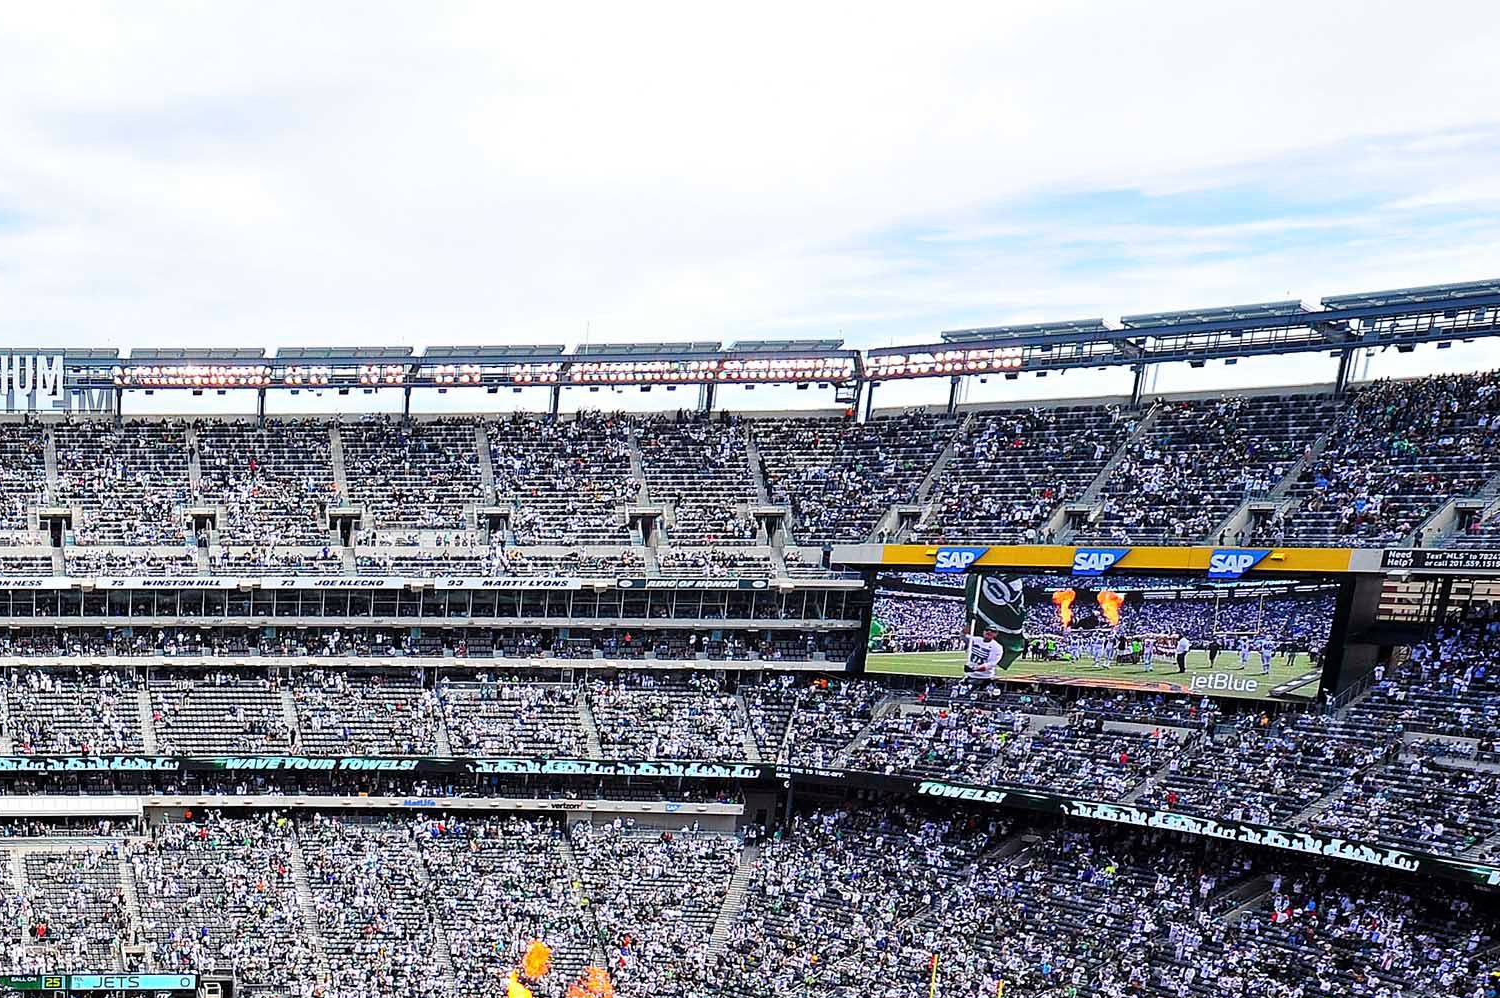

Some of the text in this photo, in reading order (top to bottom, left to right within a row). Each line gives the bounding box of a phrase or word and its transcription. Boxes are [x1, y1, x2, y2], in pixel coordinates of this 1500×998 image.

[1388, 550, 1413, 559] Need
[1426, 552, 1443, 560] Text
[936, 551, 975, 569] SAP
[1074, 552, 1115, 571] SAP
[1209, 554, 1255, 574] SAP
[1387, 558, 1414, 567] Help?
[1433, 559, 1448, 567] call
[482, 579, 527, 587] MARTY
[529, 579, 568, 587] LYONS
[678, 580, 694, 588] OF
[1188, 672, 1258, 692] jetBlue
[225, 758, 419, 770] WAVE YOUR TOWELS!
[918, 782, 1007, 802] TOWELS!
[403, 799, 437, 807] MetLife
[551, 800, 582, 809] verizon
[46, 977, 61, 988] 25
[93, 976, 191, 989] JETS 0
